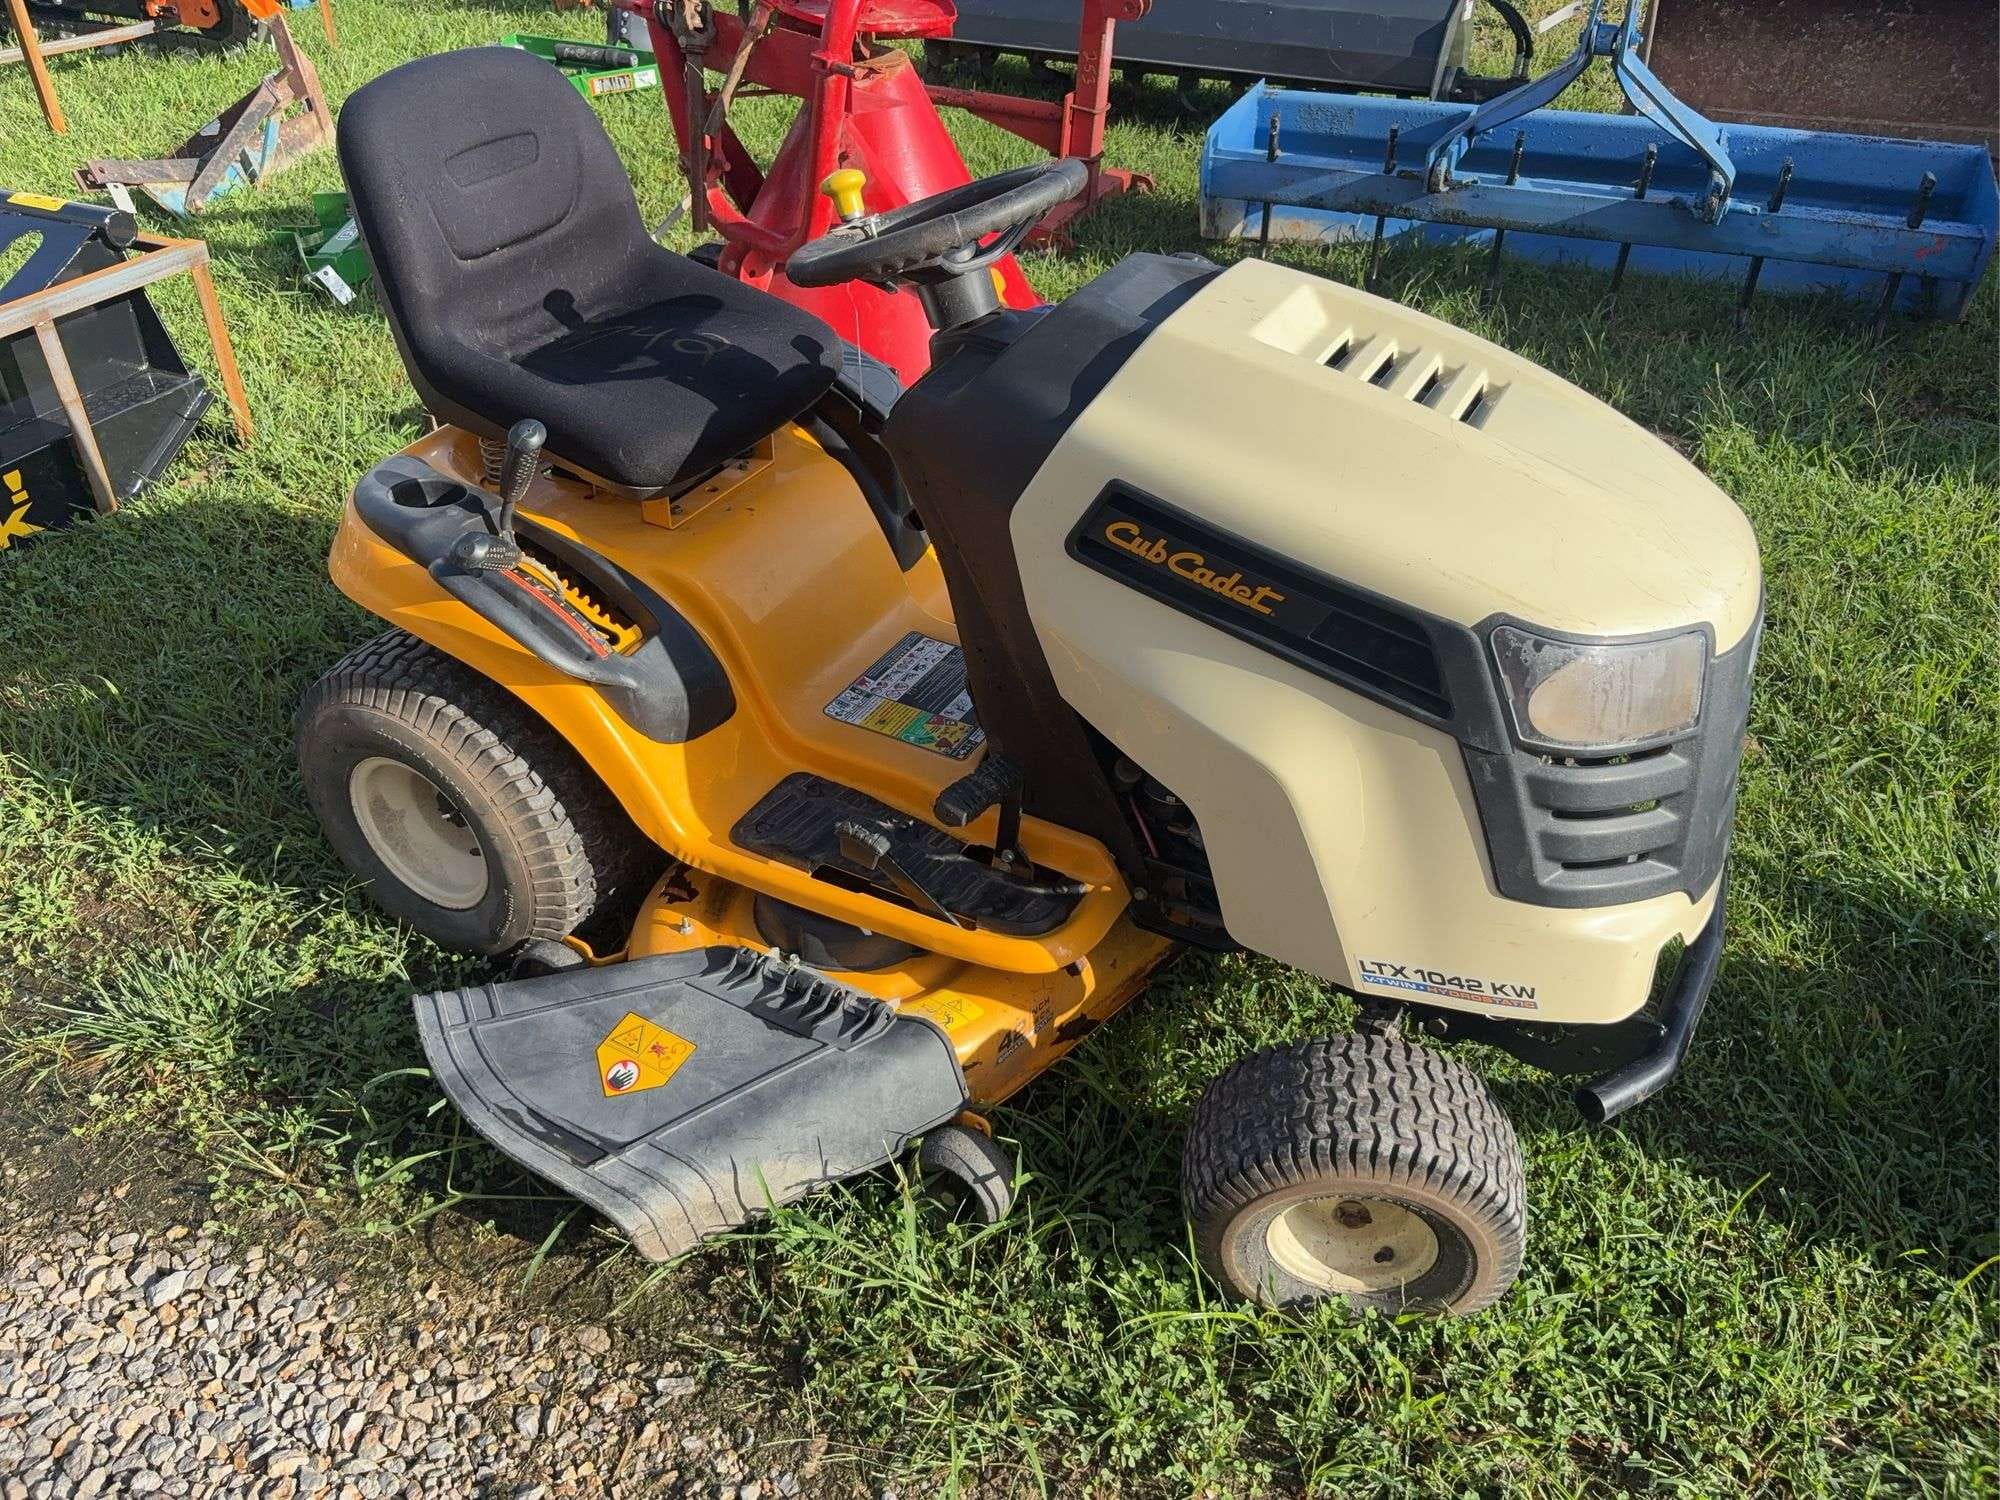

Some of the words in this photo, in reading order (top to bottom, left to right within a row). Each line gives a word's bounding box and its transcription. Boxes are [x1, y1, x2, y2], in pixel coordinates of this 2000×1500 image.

[1104, 519, 1168, 565] Cub
[1168, 551, 1286, 615] Cadet
[1358, 959, 1410, 980] LTX
[1413, 967, 1485, 994] 1042
[1490, 980, 1537, 1001] KW
[1363, 975, 1418, 990] V-TWIN
